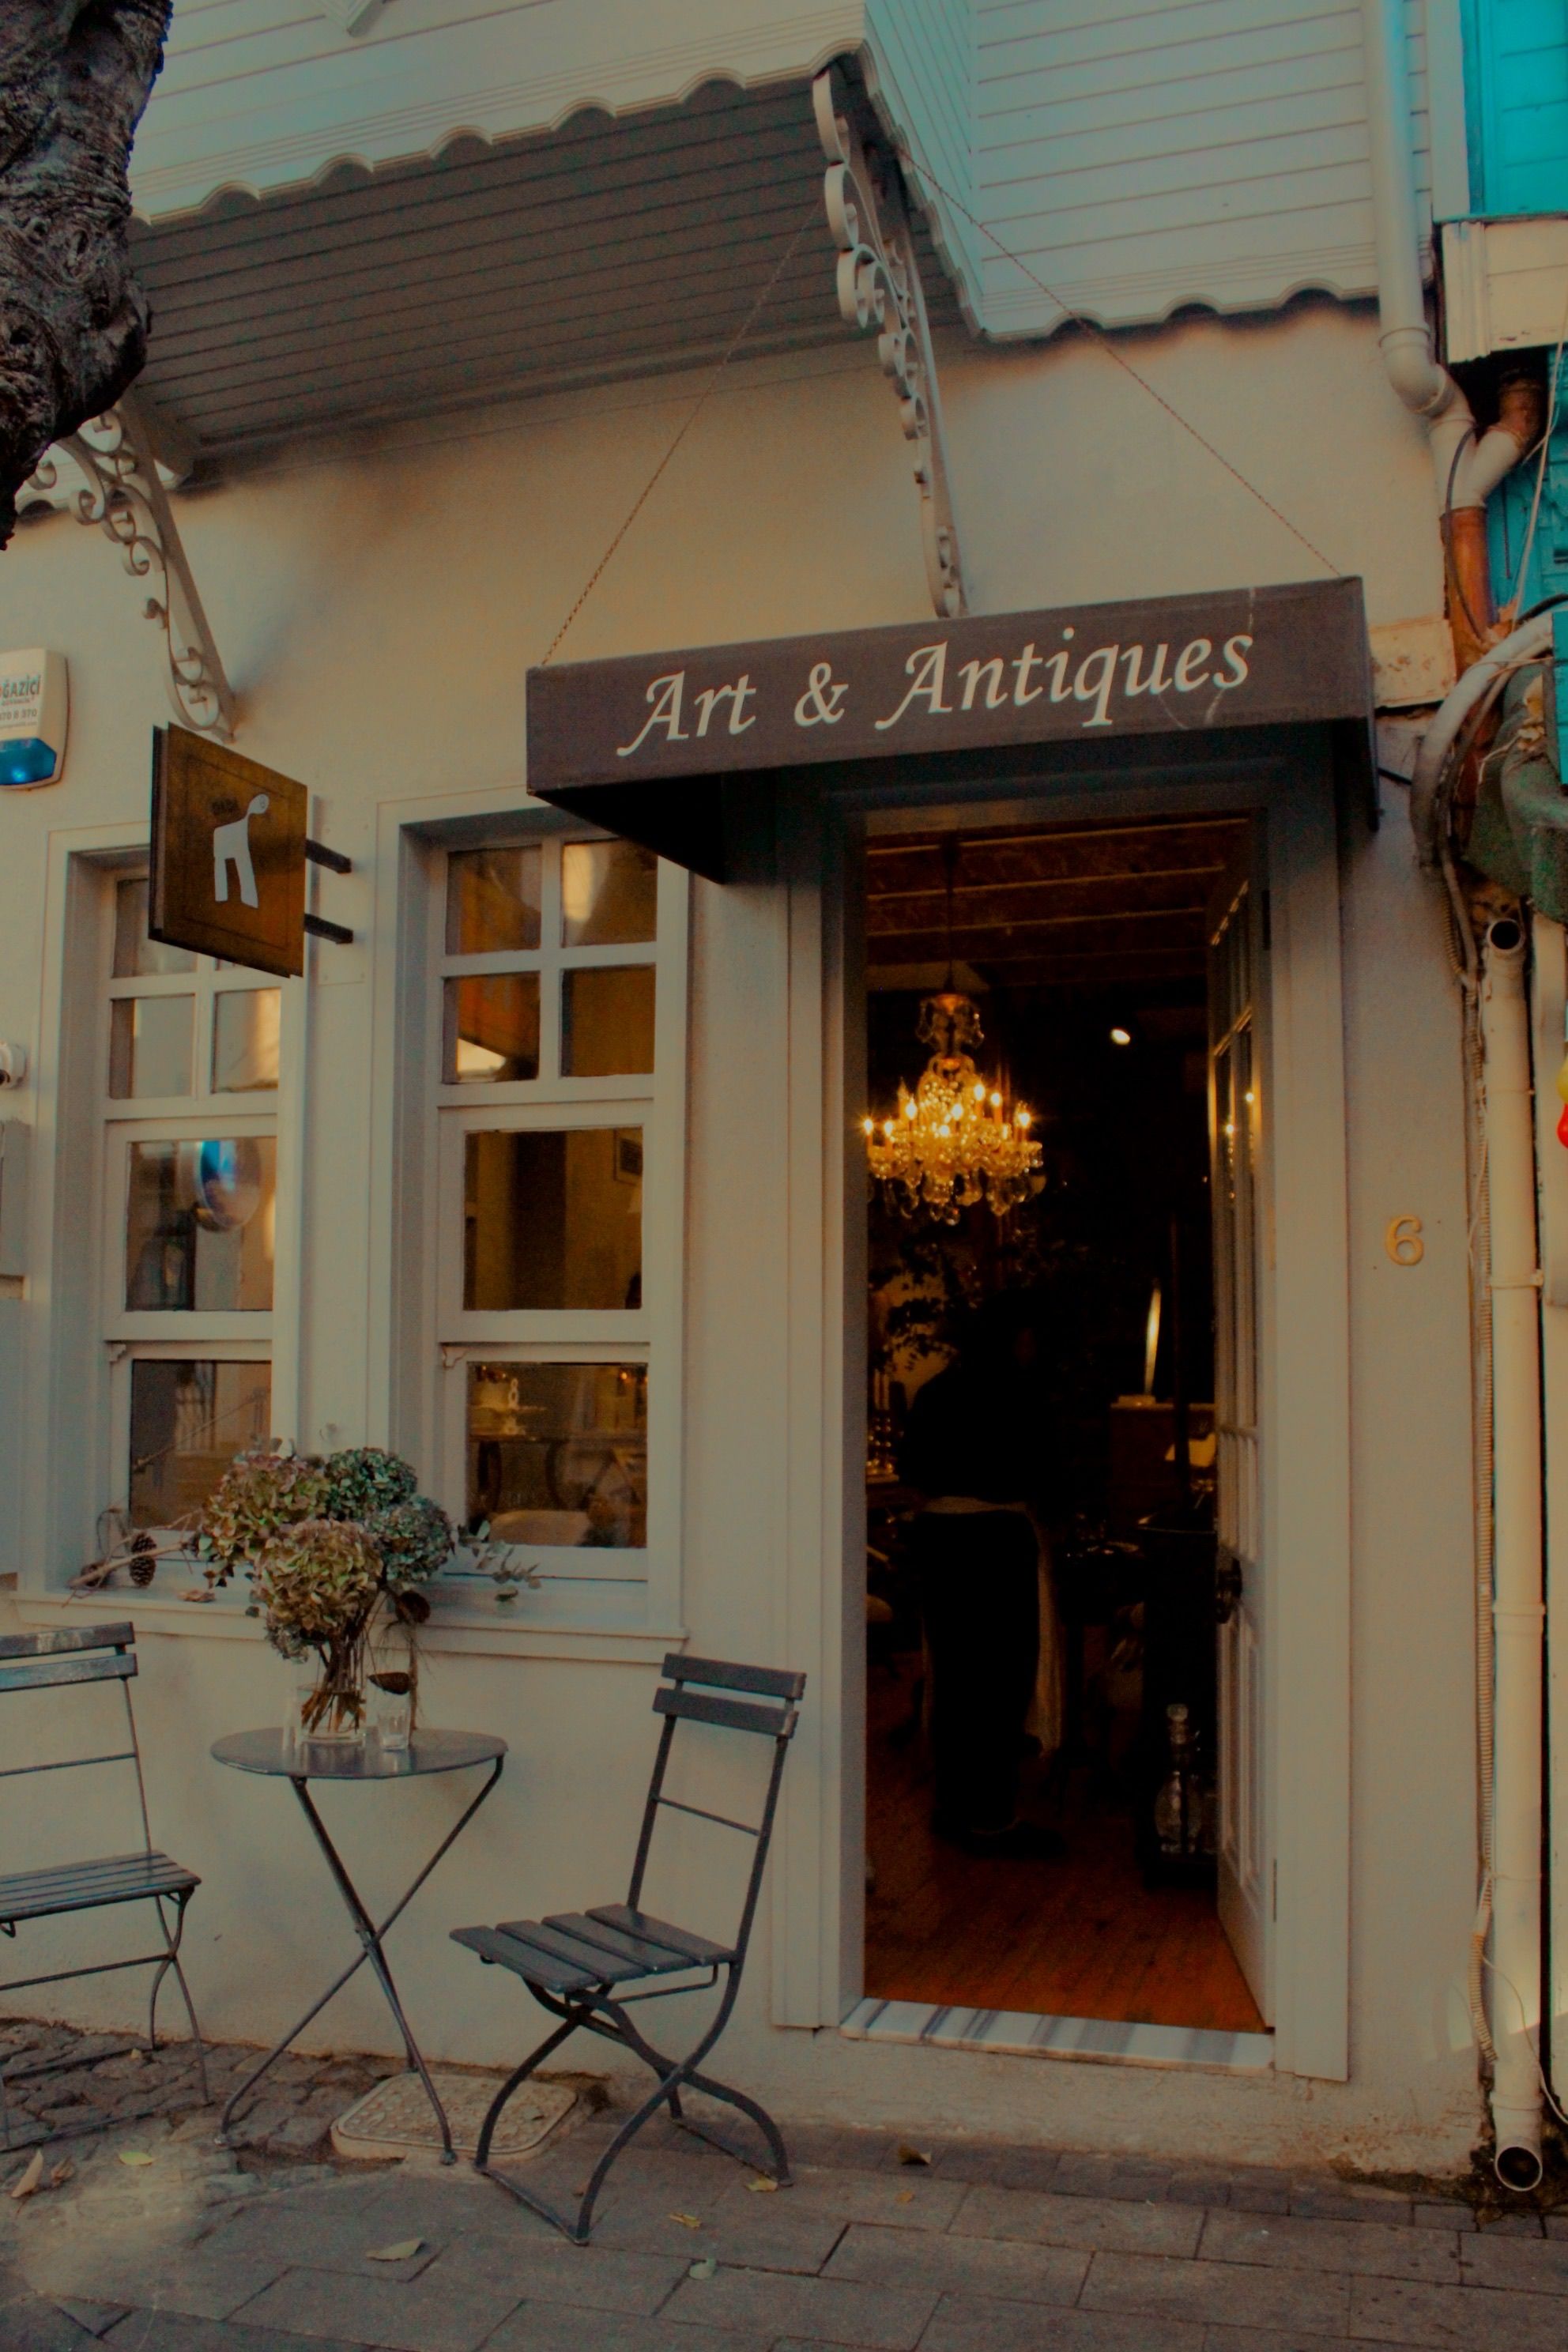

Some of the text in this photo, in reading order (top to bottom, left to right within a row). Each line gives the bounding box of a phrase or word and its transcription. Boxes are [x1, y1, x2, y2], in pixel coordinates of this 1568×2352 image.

[616, 627, 1253, 757] Art & Antiques
[1385, 1215, 1423, 1265] 6
